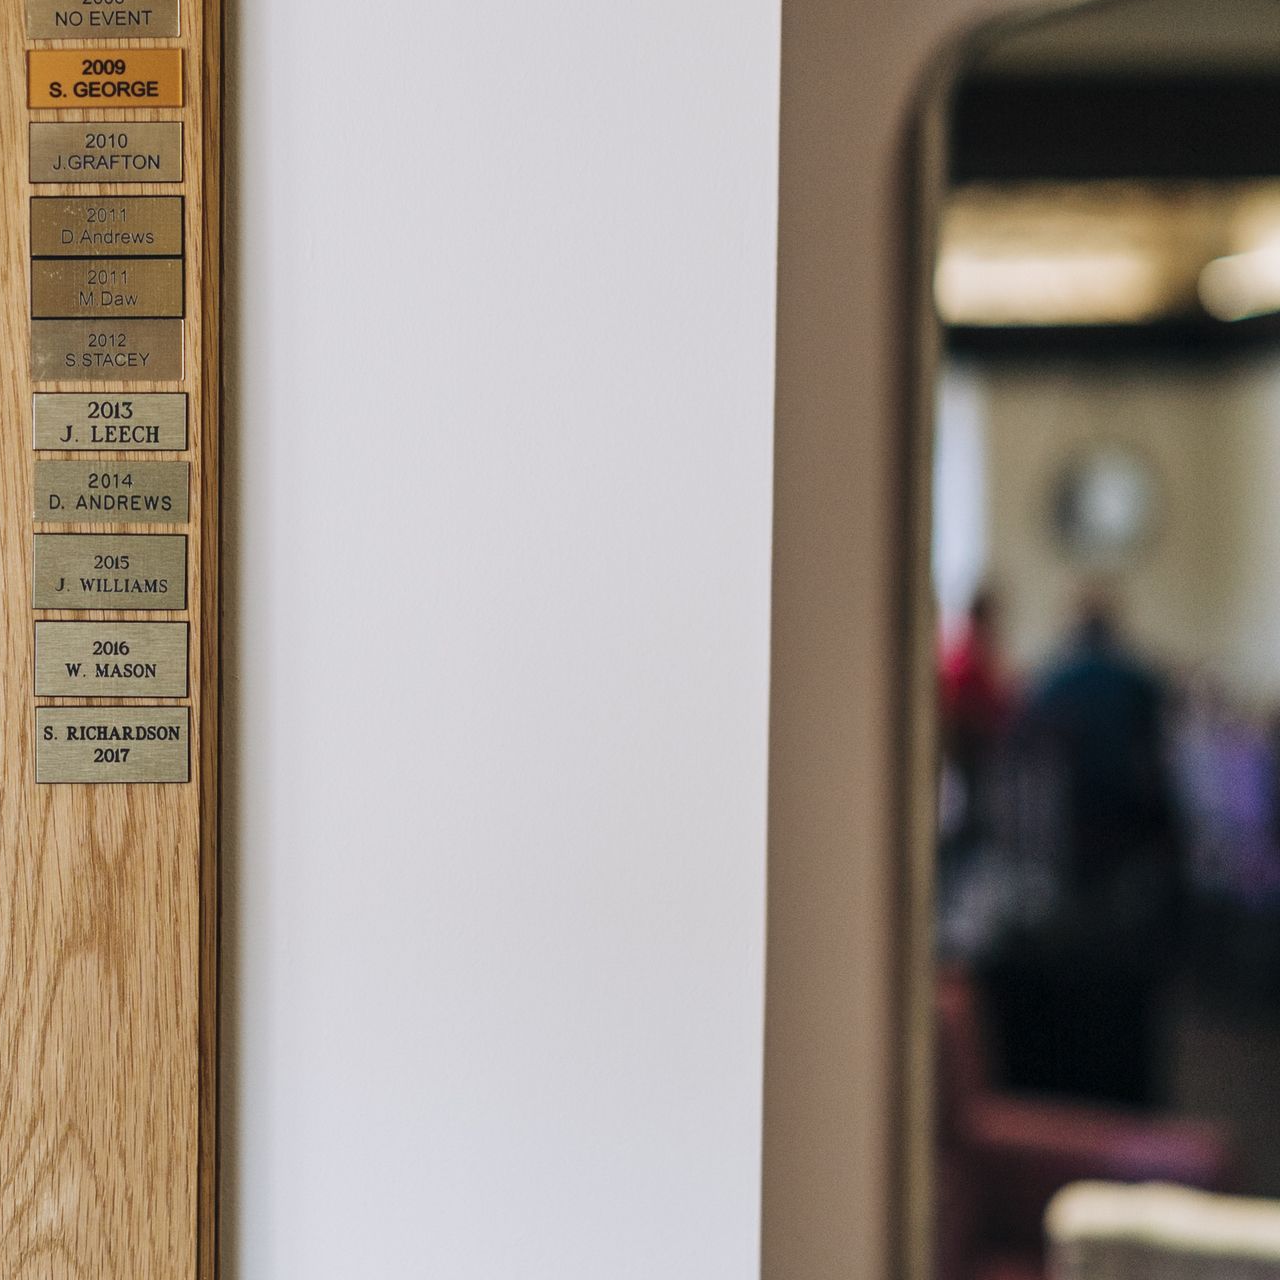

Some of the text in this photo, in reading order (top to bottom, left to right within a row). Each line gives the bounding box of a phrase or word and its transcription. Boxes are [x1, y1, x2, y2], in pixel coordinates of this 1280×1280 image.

[55, 11, 152, 26] NO EVENT
[82, 59, 126, 75] 2009
[49, 81, 159, 98] S. GEORGE
[85, 134, 128, 148] 2010
[87, 208, 127, 222] 2011
[88, 270, 127, 285] 2011
[88, 334, 126, 347] 2012
[87, 401, 133, 420] 2013
[60, 425, 159, 443] J. LEECH
[88, 473, 133, 489] 2014
[49, 495, 172, 511] D. ANDREWS
[94, 555, 130, 570] 2015
[55, 578, 168, 593] J. WILLIAMS
[92, 641, 130, 656] 2016
[66, 663, 157, 678] W. MASON
[44, 726, 180, 741] S. RICHARDSON
[94, 748, 130, 763] 2017
